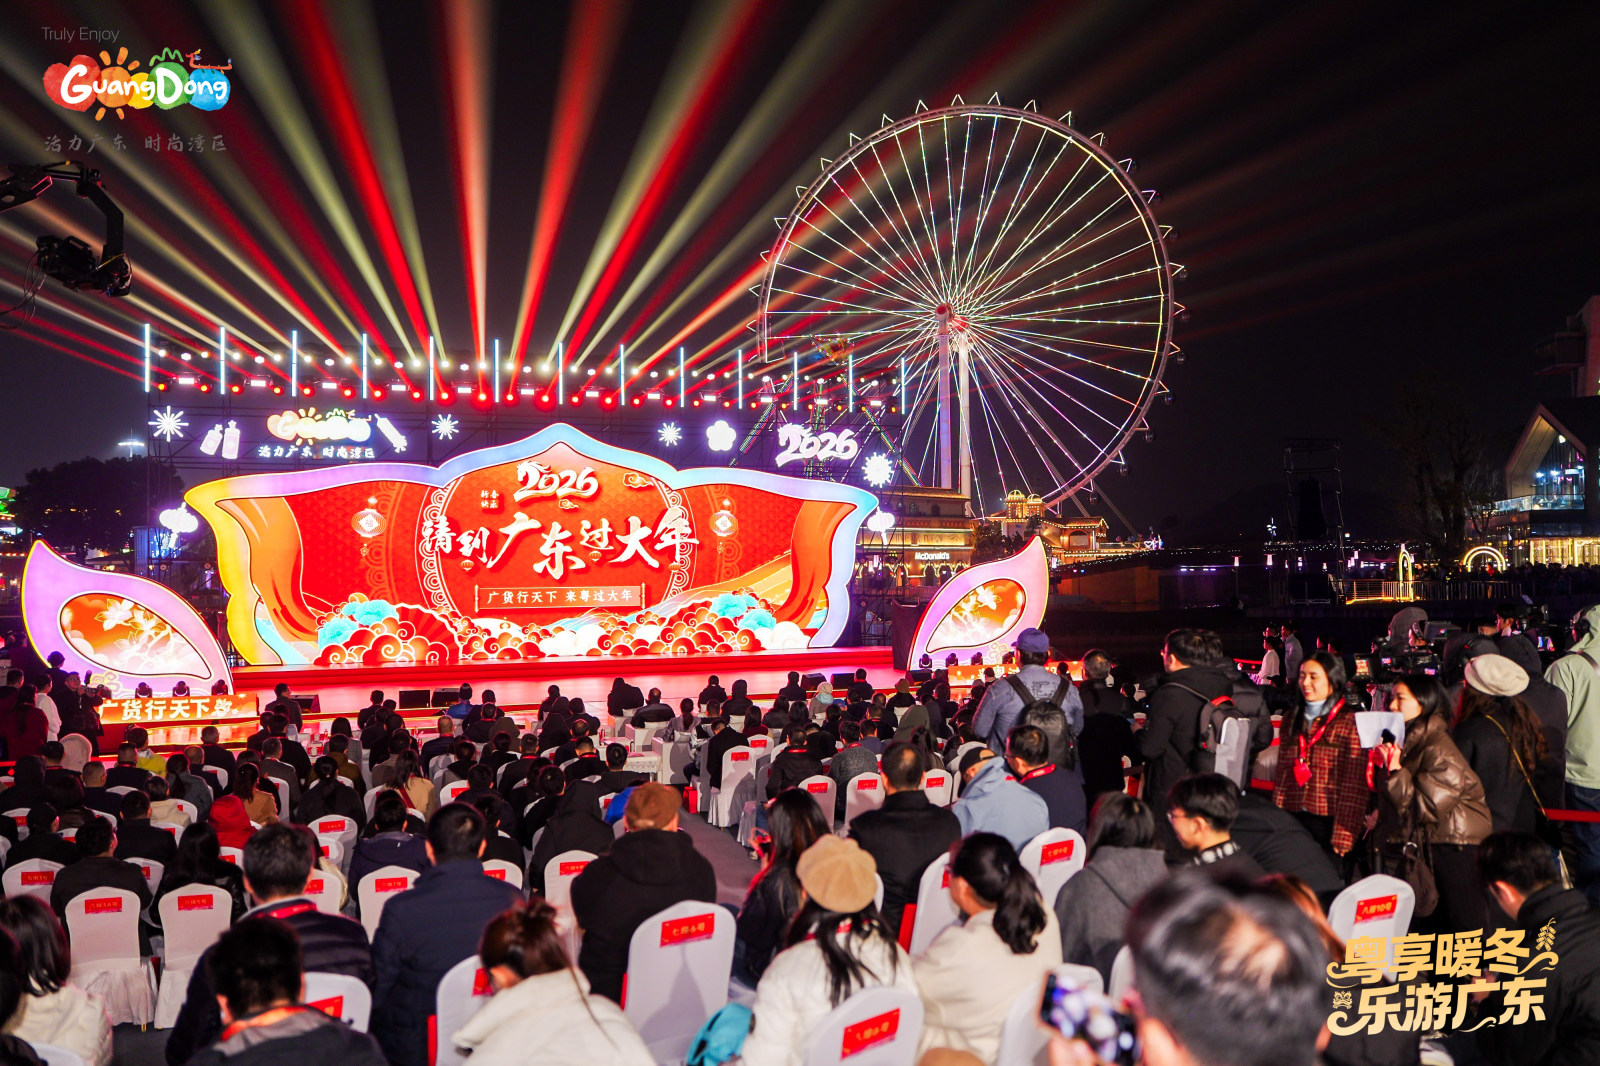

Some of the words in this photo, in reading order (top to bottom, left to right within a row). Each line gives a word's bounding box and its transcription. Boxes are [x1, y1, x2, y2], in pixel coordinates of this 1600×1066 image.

[774, 422, 858, 468] 2026
[513, 461, 599, 503] 2026
[422, 507, 699, 580] 请到广东过大年
[915, 552, 950, 561] McDonald's
[487, 590, 558, 604] 广货行天下
[565, 589, 633, 603] 来粤过大年
[99, 697, 210, 721] 广货行天下
